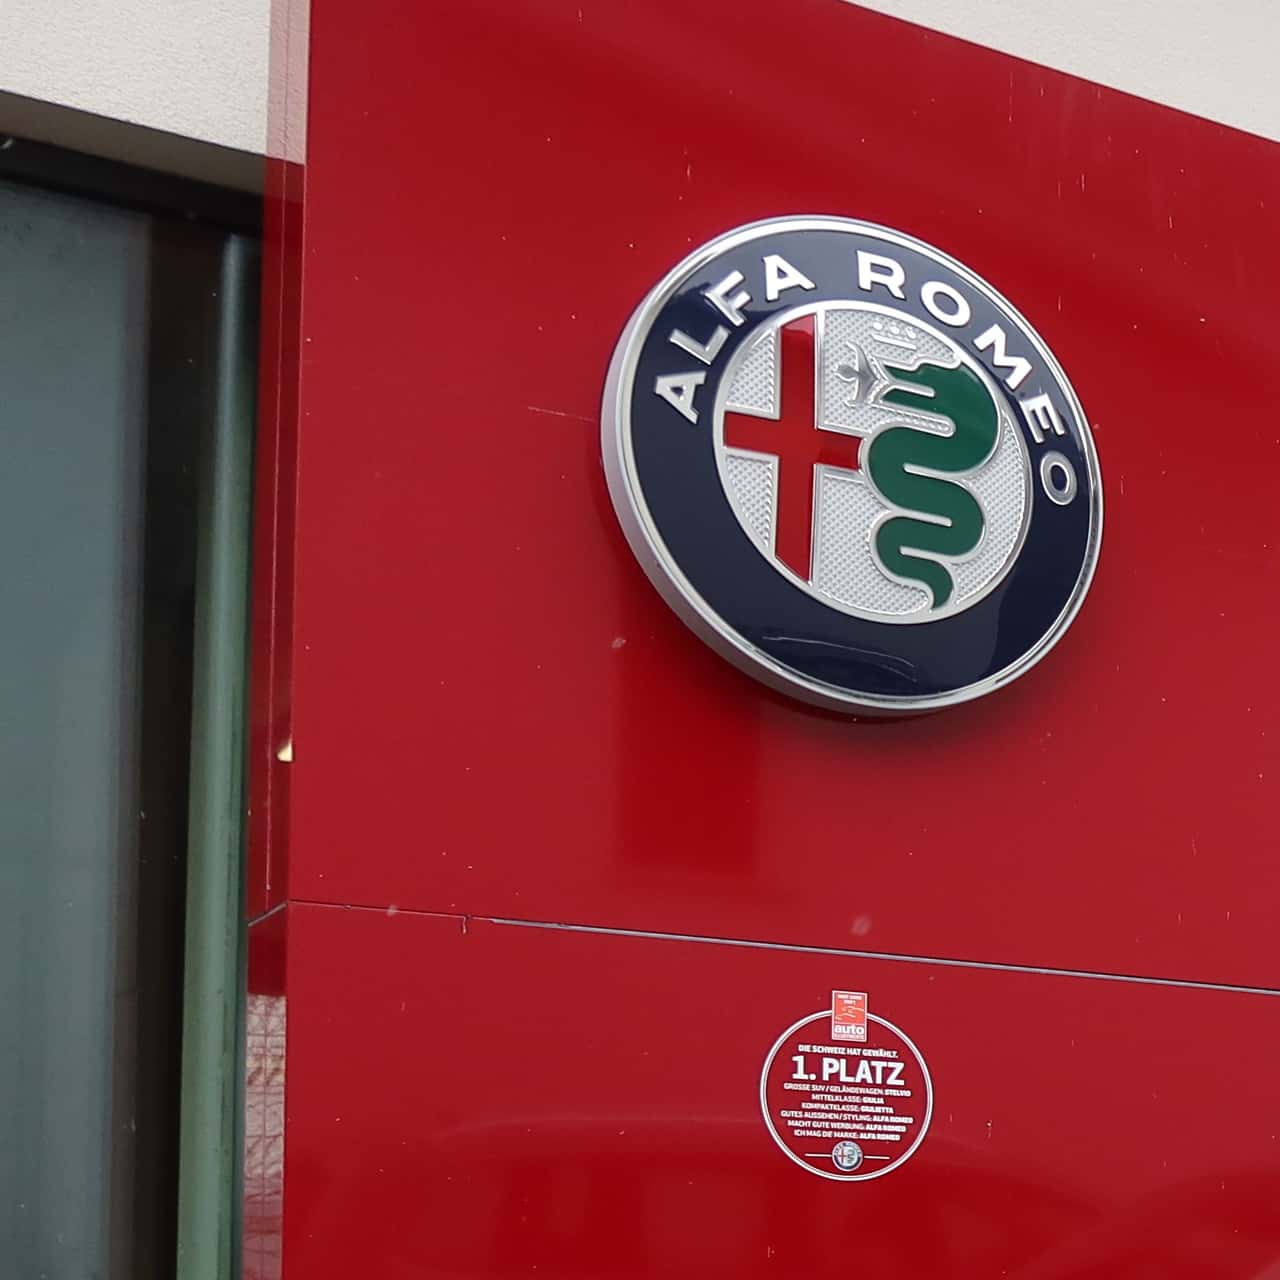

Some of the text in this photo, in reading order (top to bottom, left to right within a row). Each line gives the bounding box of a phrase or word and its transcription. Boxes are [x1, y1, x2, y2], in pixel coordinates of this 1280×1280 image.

[655, 249, 1079, 507] ALFA ROMEO
[834, 1024, 864, 1034] auto
[792, 1055, 905, 1086] 1. PLATZ
